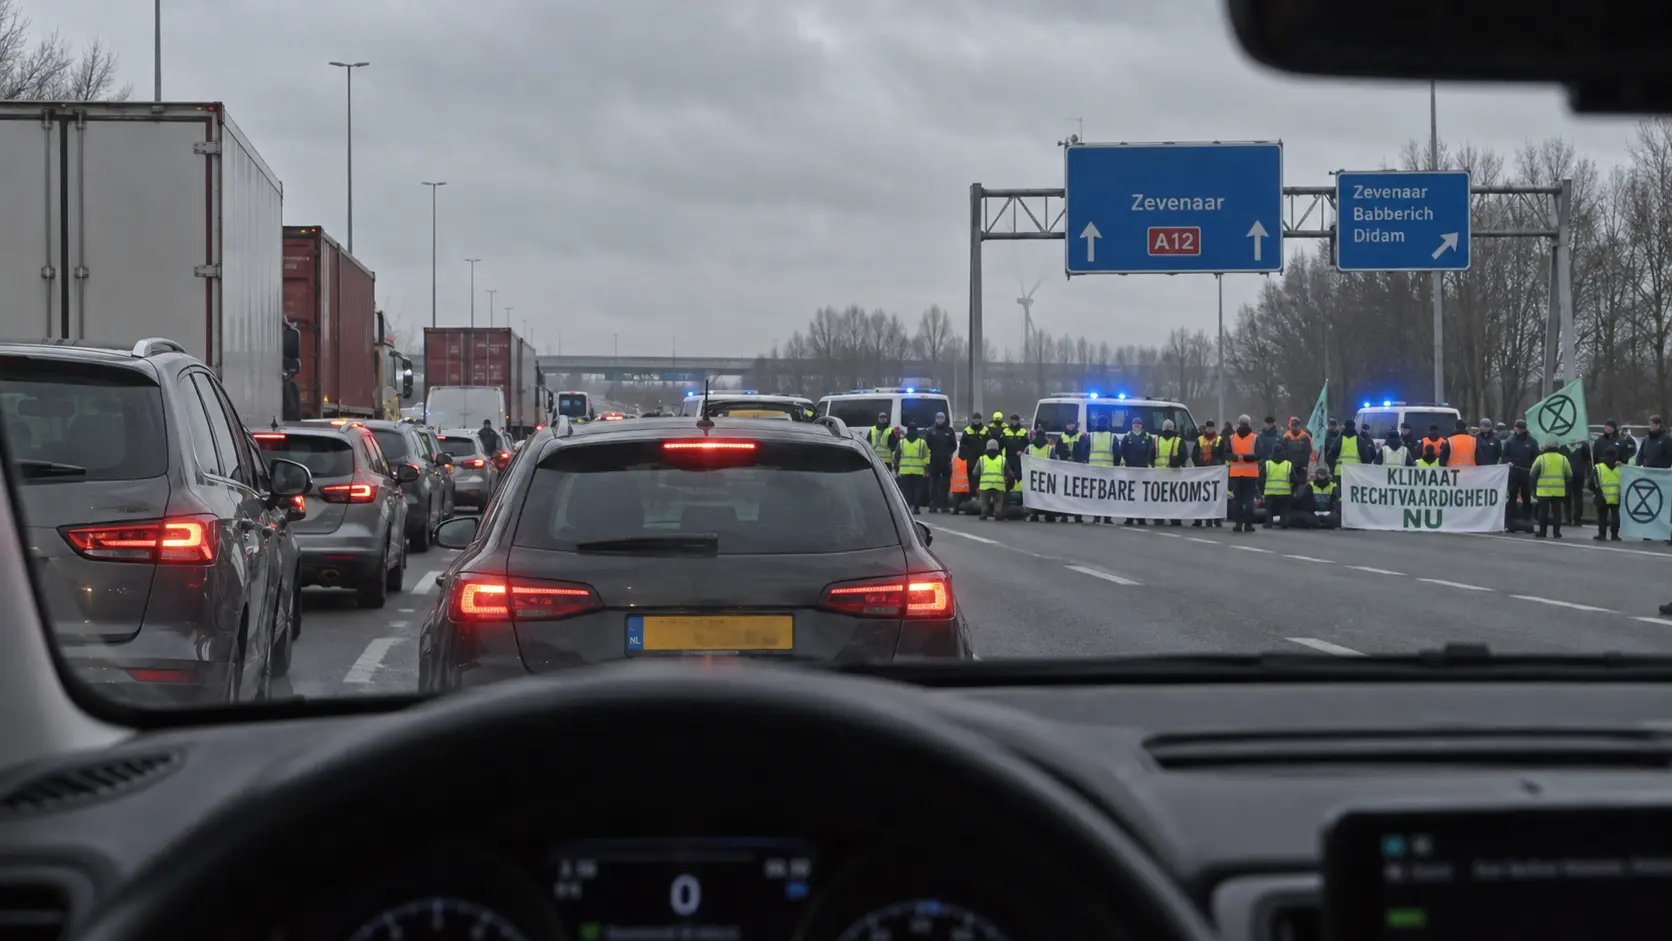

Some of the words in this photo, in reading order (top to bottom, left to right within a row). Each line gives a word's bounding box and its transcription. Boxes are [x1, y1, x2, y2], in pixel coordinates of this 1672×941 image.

[1354, 184, 1428, 199] Zevenaar
[1131, 193, 1225, 211] Zevenaar
[1353, 206, 1434, 221] Babberich
[1154, 233, 1194, 250] A12
[1354, 228, 1405, 243] Didam
[1387, 467, 1460, 487] KLIMAAT
[1030, 470, 1057, 494] EEN
[1063, 475, 1136, 502] LEEFBARE
[1142, 480, 1221, 503] TOEKOMST
[1350, 485, 1498, 508] RECHTVAARDIGHEID
[1403, 509, 1443, 529] NU
[629, 636, 641, 645] NL
[670, 875, 700, 915] 0
